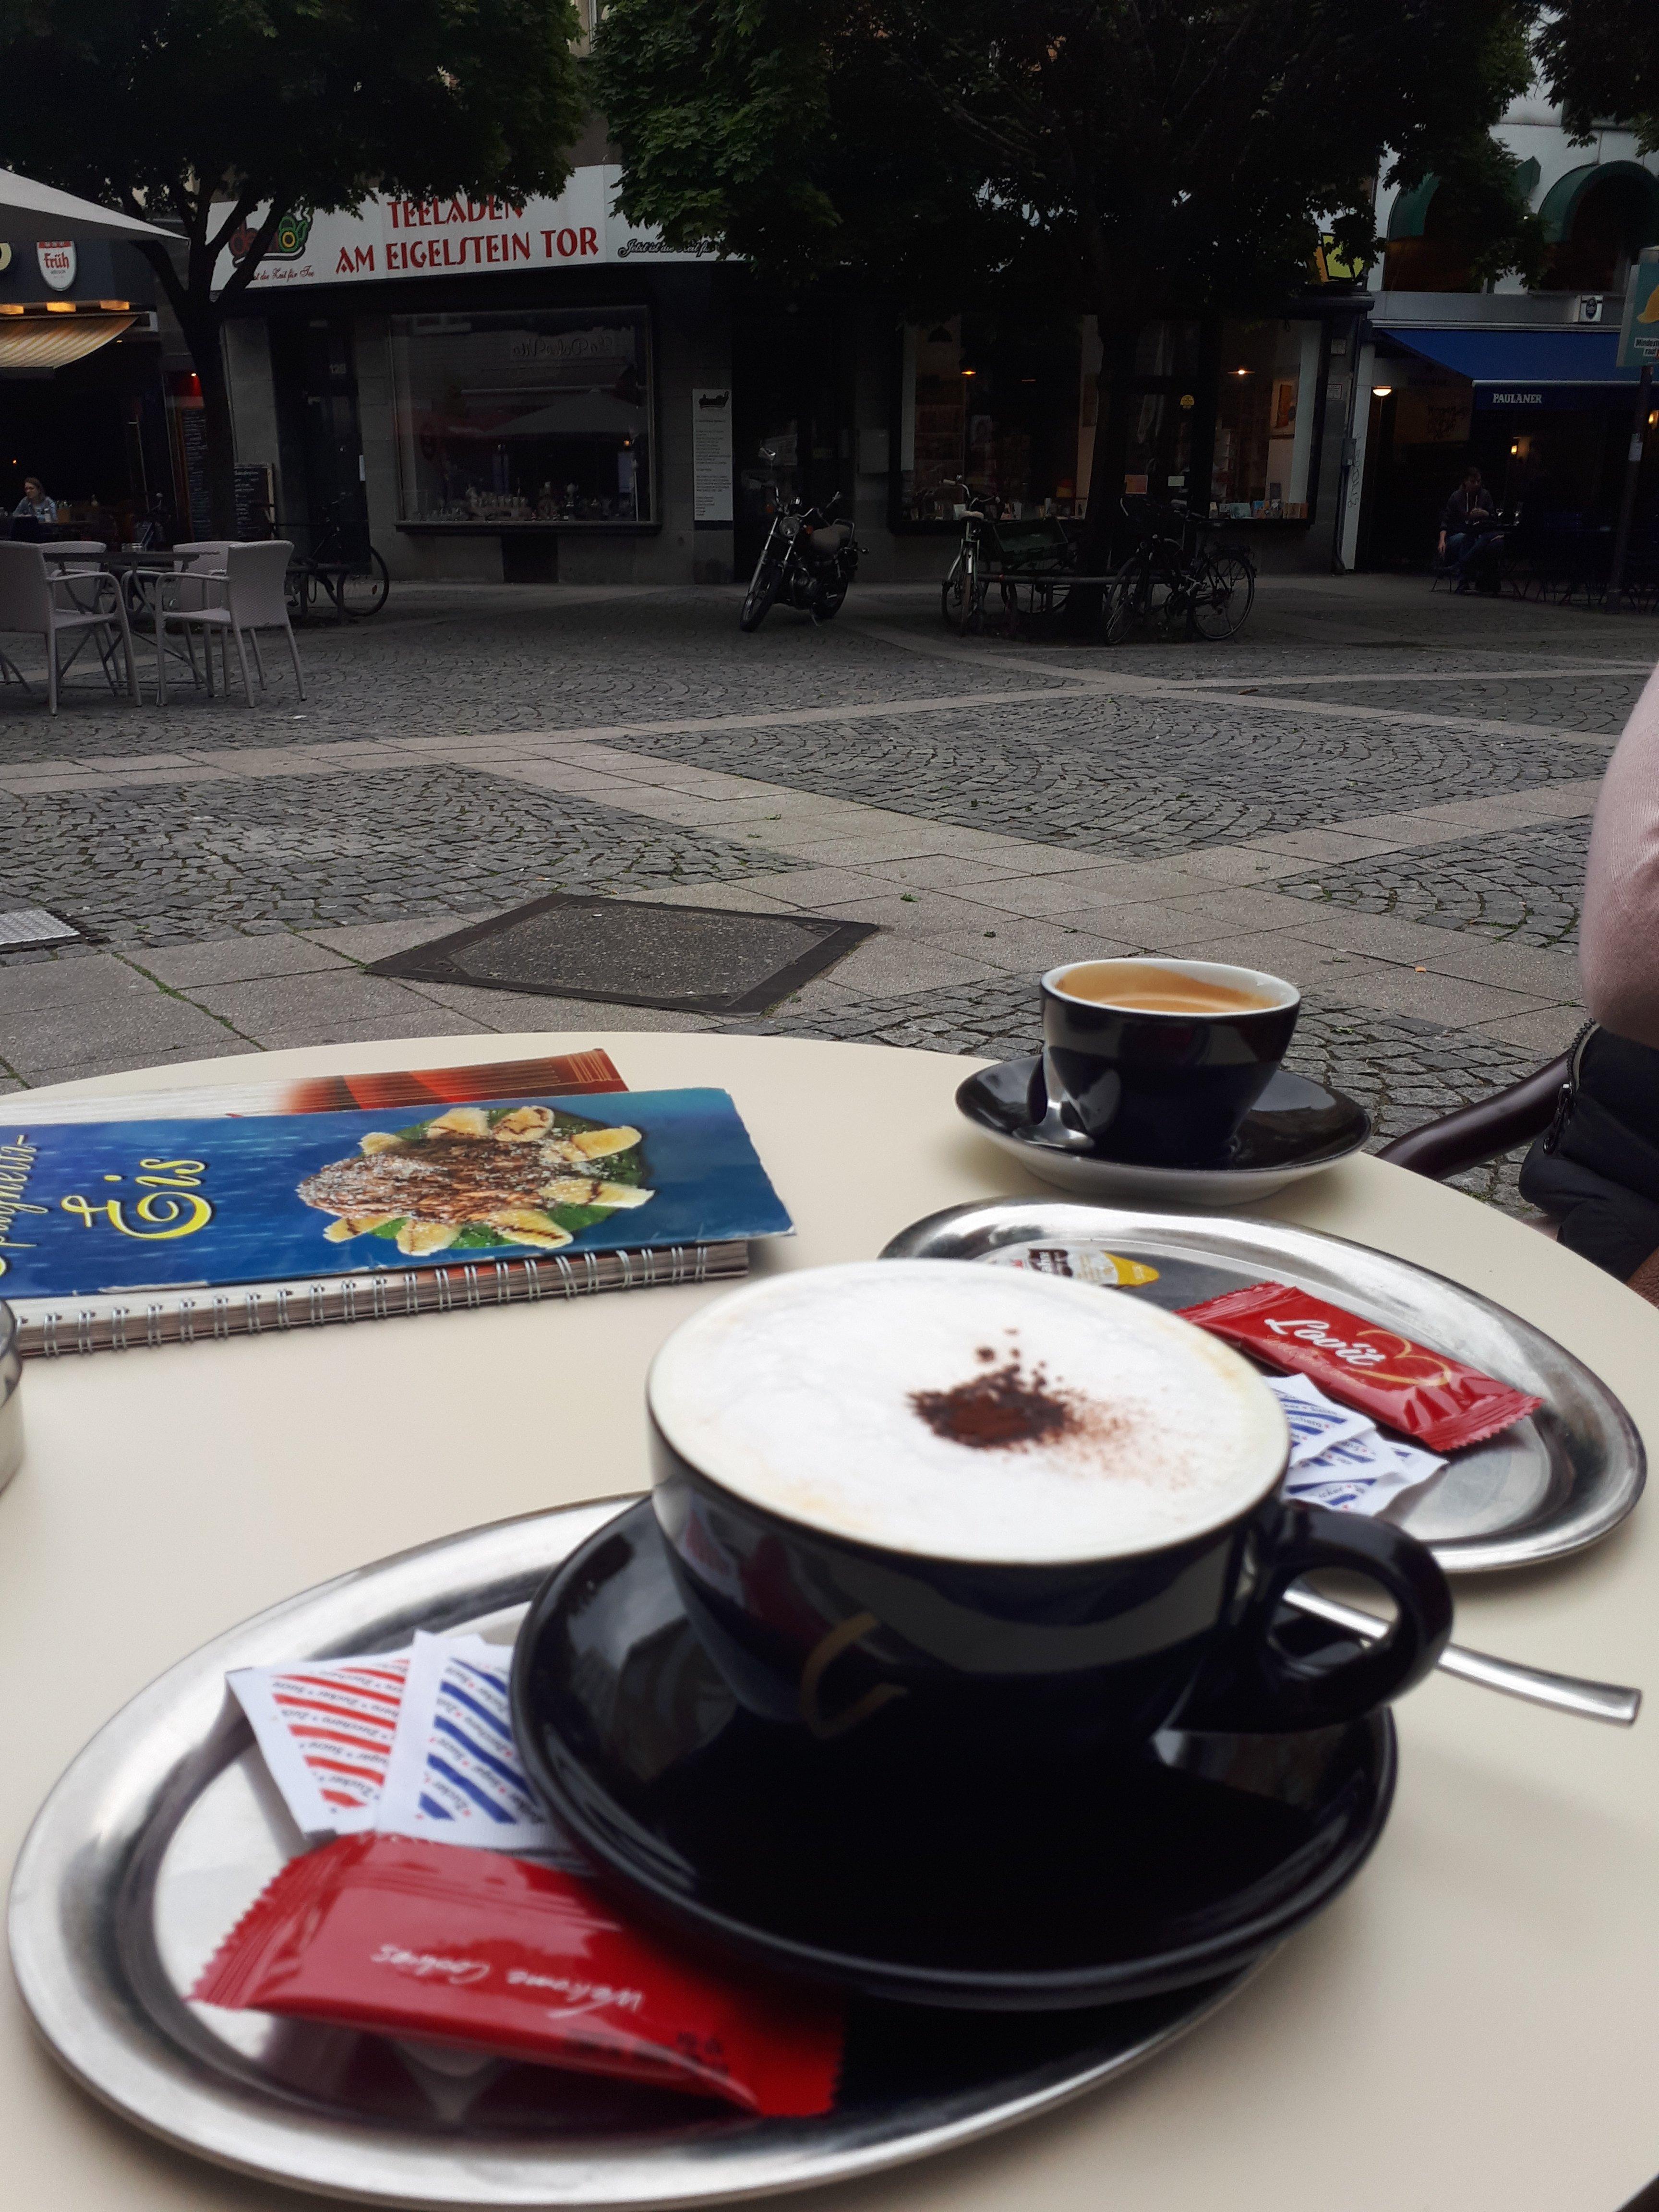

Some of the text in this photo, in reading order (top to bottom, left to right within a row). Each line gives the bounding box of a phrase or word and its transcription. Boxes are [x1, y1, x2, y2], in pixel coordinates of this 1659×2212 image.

[336, 226, 599, 274] AM EIGELSTEIN TOR
[1492, 393, 1542, 404] PAULANER
[61, 1158, 213, 1240] Eis
